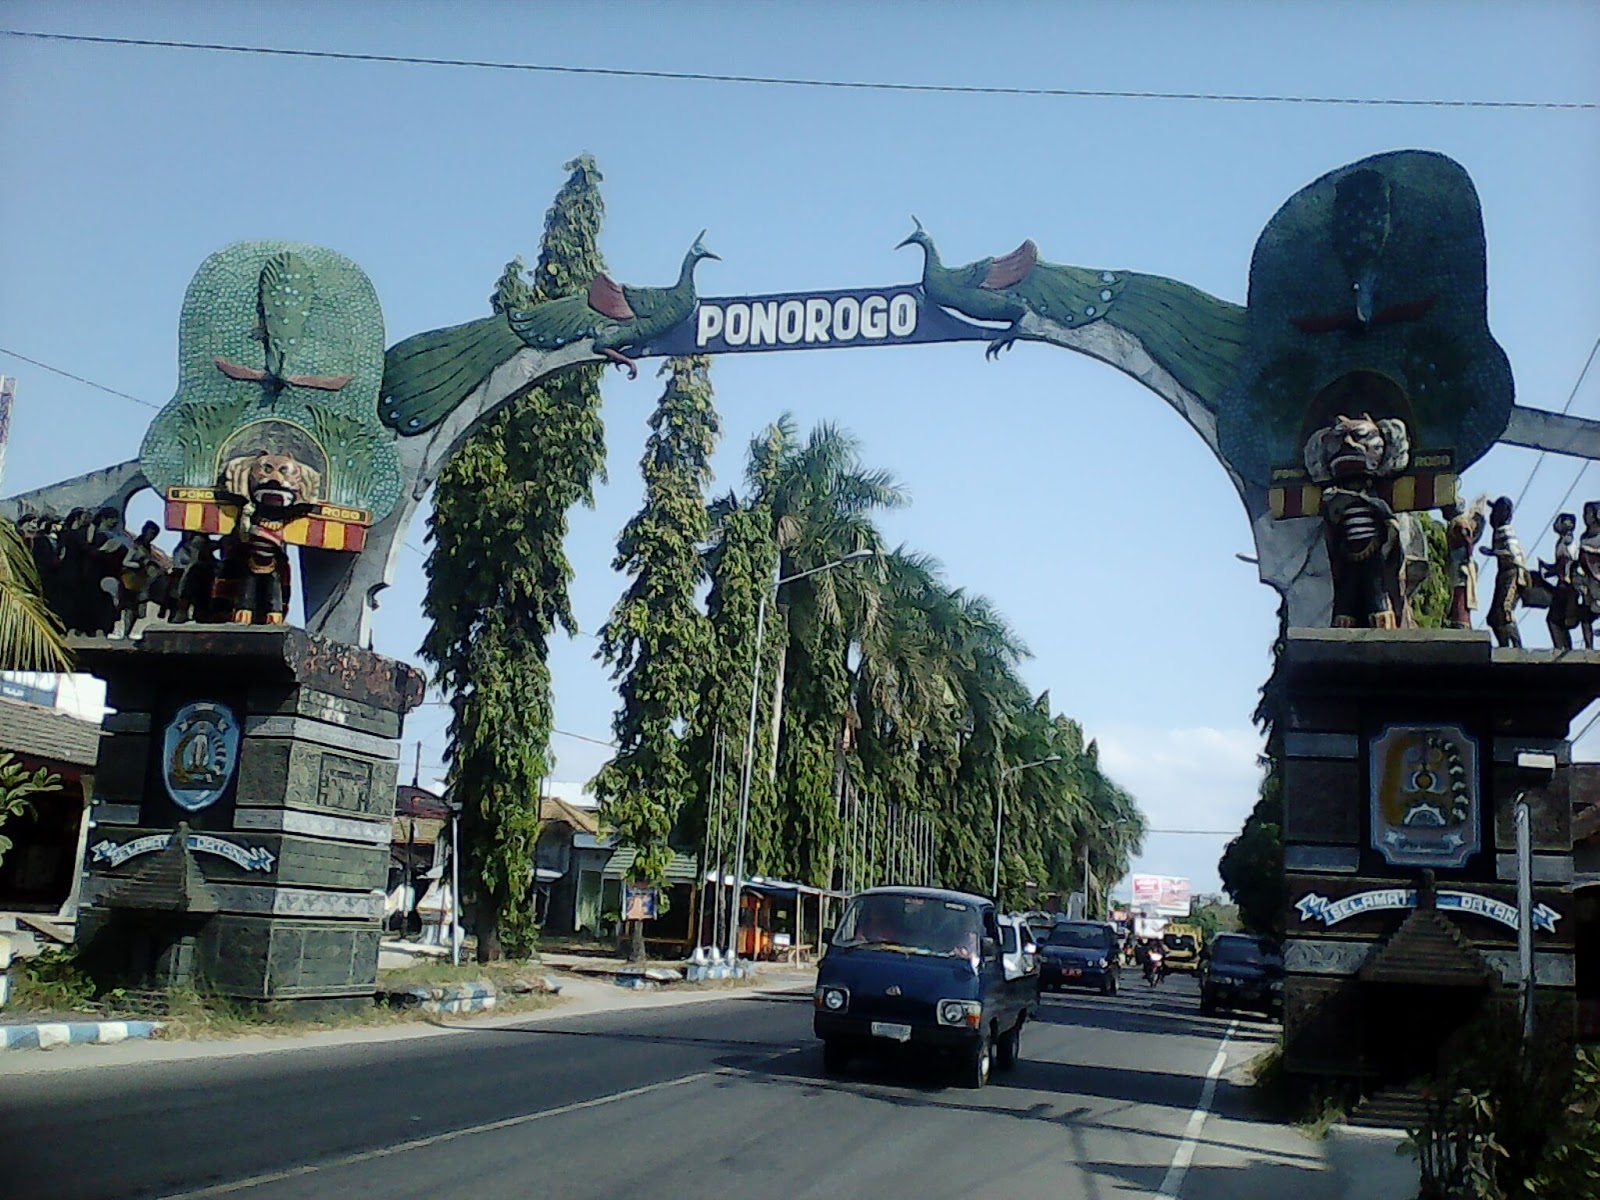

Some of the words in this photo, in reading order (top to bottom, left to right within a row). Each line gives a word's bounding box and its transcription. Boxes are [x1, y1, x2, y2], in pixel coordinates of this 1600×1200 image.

[696, 294, 917, 347] PONOROGO
[178, 490, 214, 500] PONO
[113, 836, 169, 861] SELAMAT
[1330, 890, 1407, 920] SELAMAT
[1461, 896, 1519, 925] DATAN
